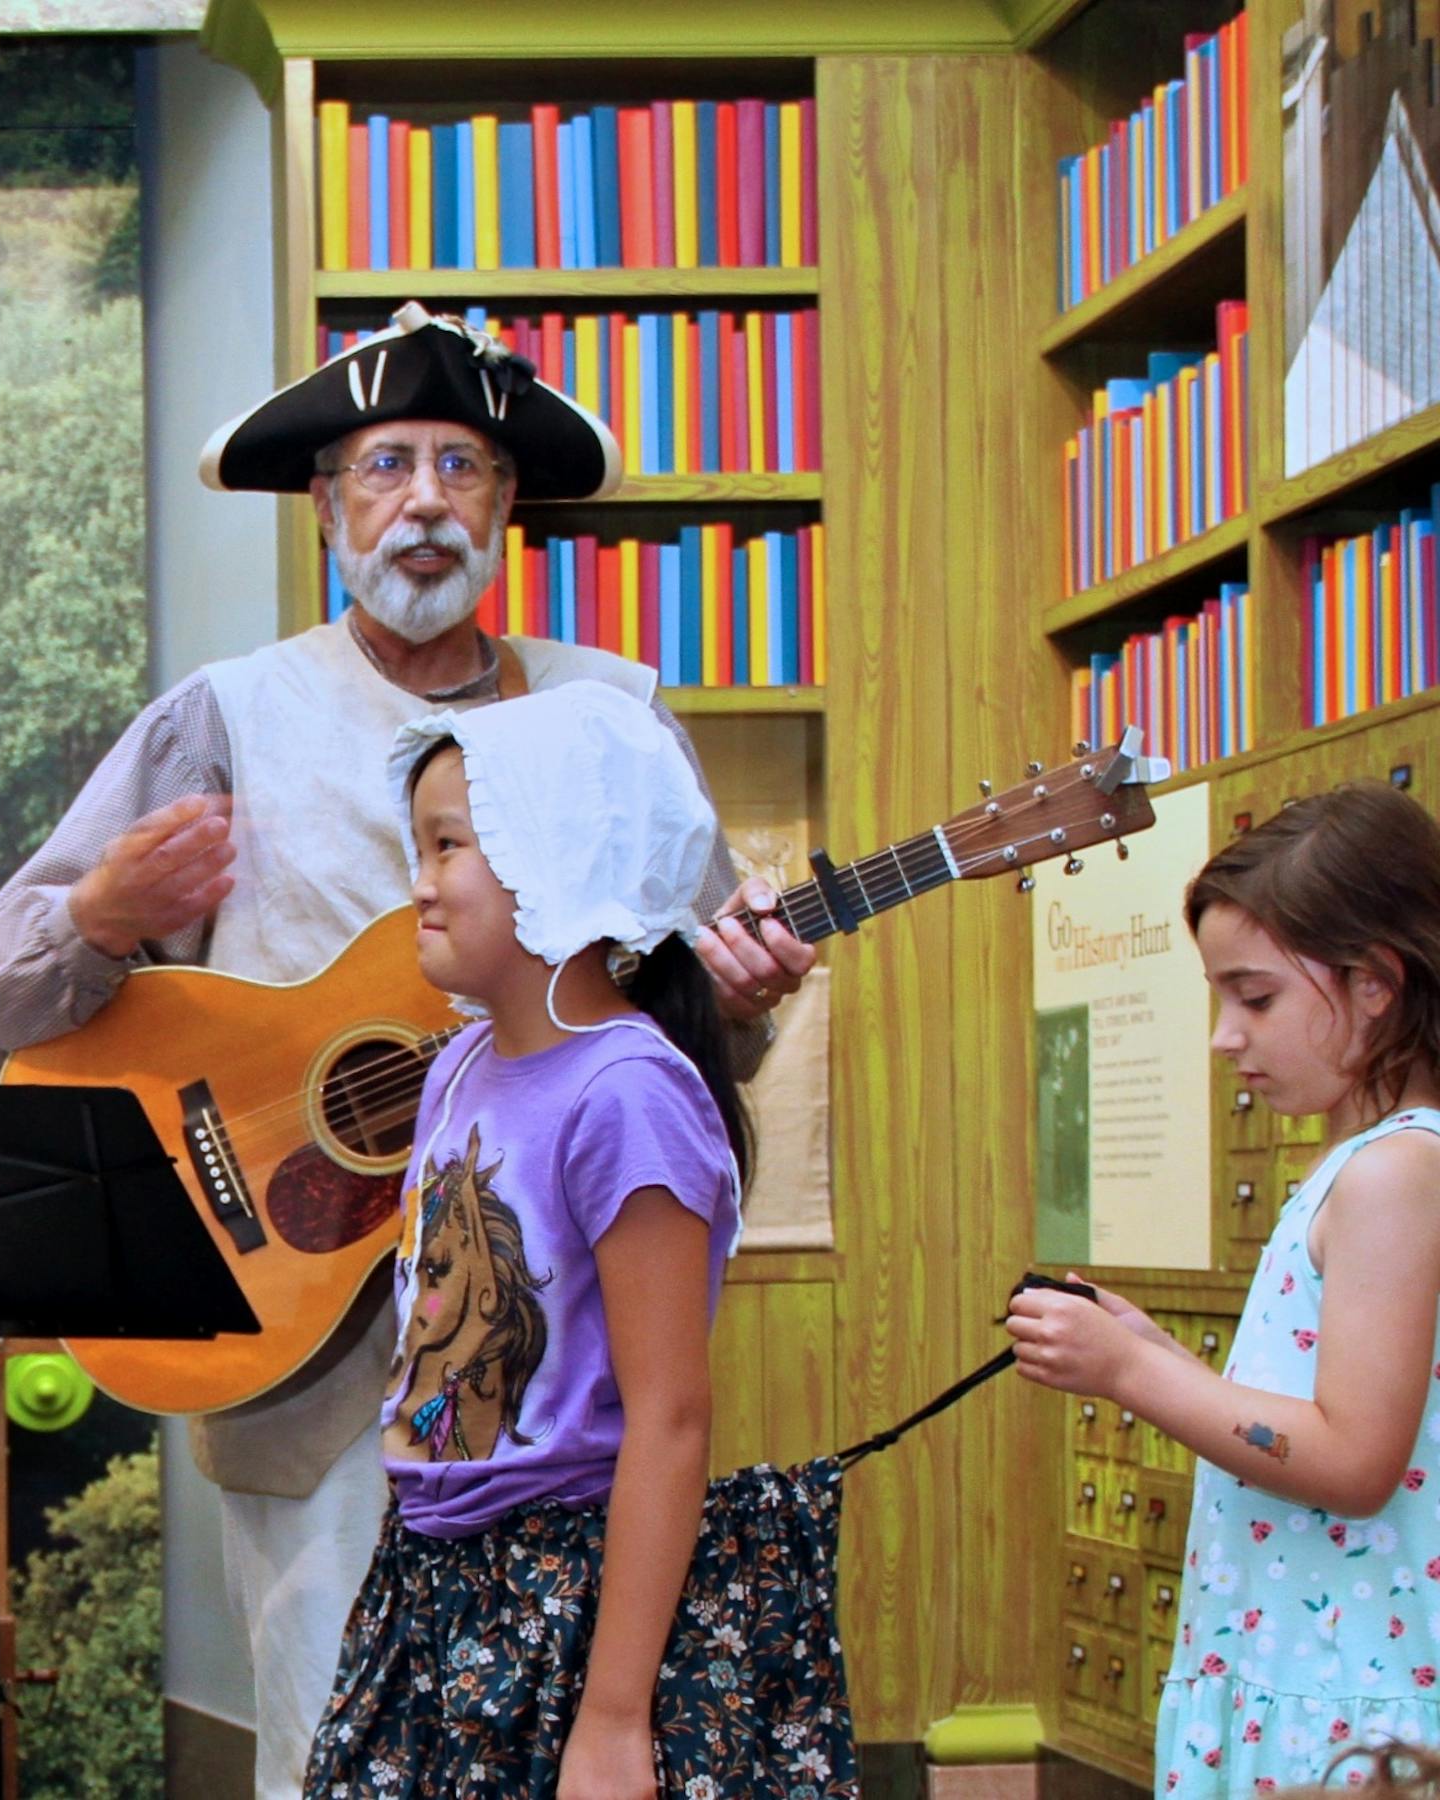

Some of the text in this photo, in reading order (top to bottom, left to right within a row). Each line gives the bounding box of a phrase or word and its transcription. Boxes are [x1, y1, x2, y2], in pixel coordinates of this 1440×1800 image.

[1048, 901, 1071, 951] Go
[1073, 914, 1170, 970] History Hunt
